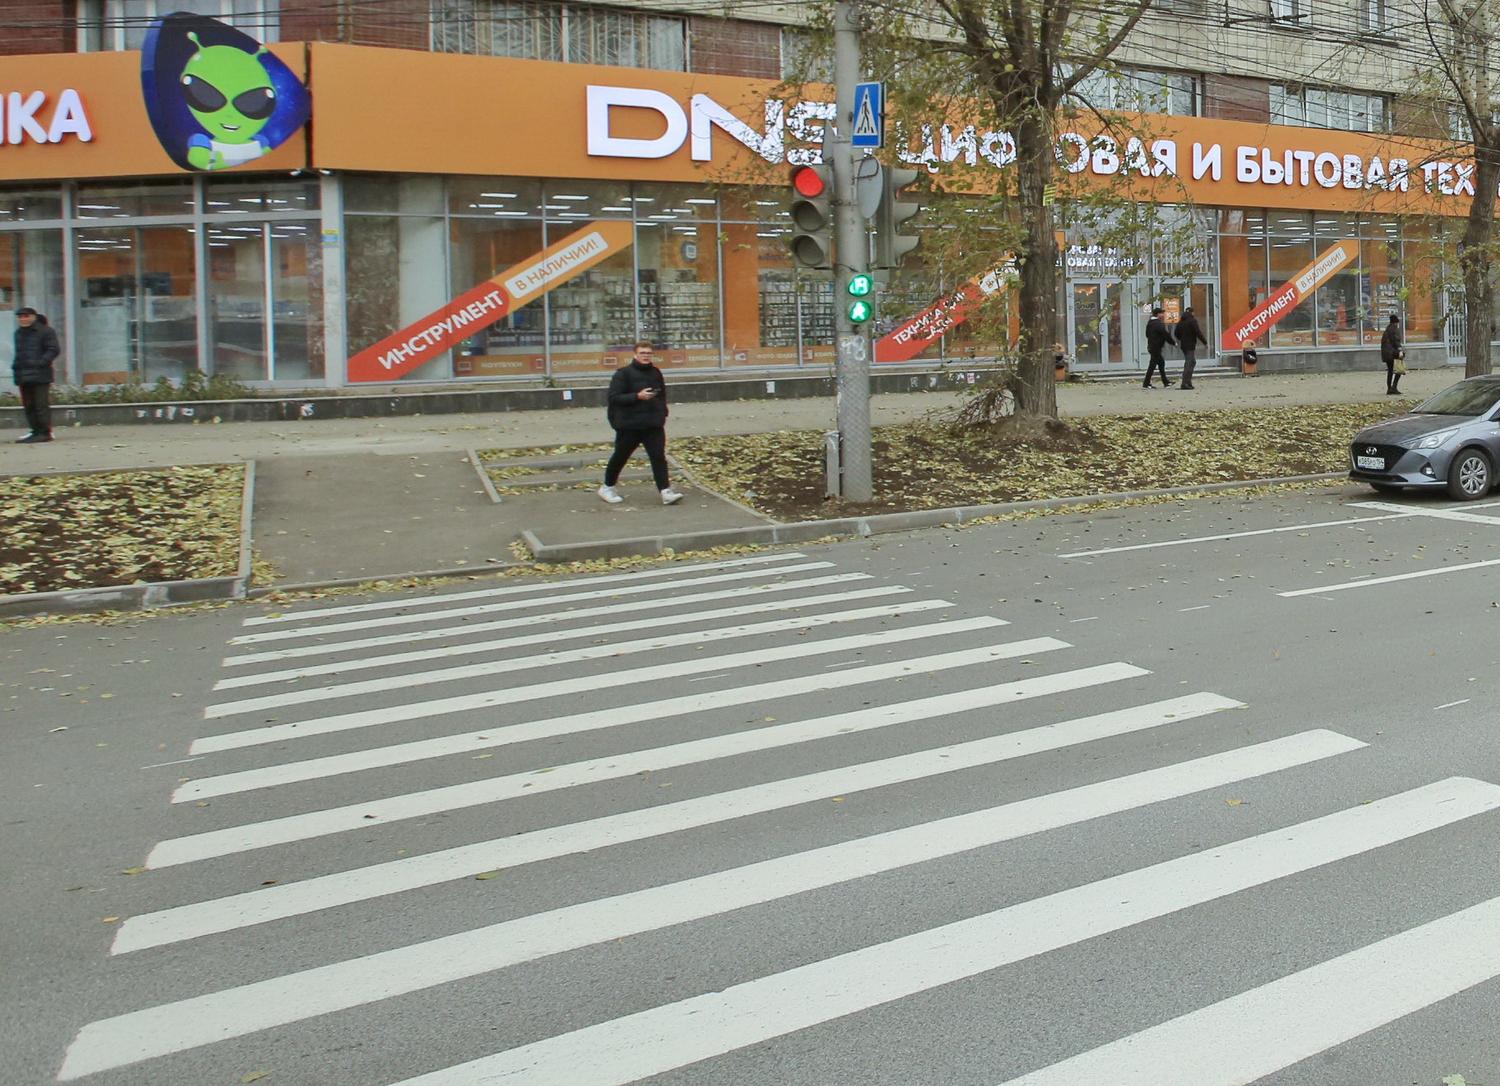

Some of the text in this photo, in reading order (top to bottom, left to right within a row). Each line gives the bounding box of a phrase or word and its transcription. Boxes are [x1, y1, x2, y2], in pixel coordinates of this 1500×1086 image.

[0, 88, 93, 145] КА
[586, 84, 838, 166] DNS
[895, 121, 1177, 177] ЦИФОВАЯ
[1192, 142, 1222, 181] И
[1236, 146, 1410, 192] БЫТОВАЯ
[378, 240, 598, 369] ИНСТРУМЕНТ В НАЛИЧИИ!
[1236, 288, 1296, 341] ИНСТРУМЕНТ
